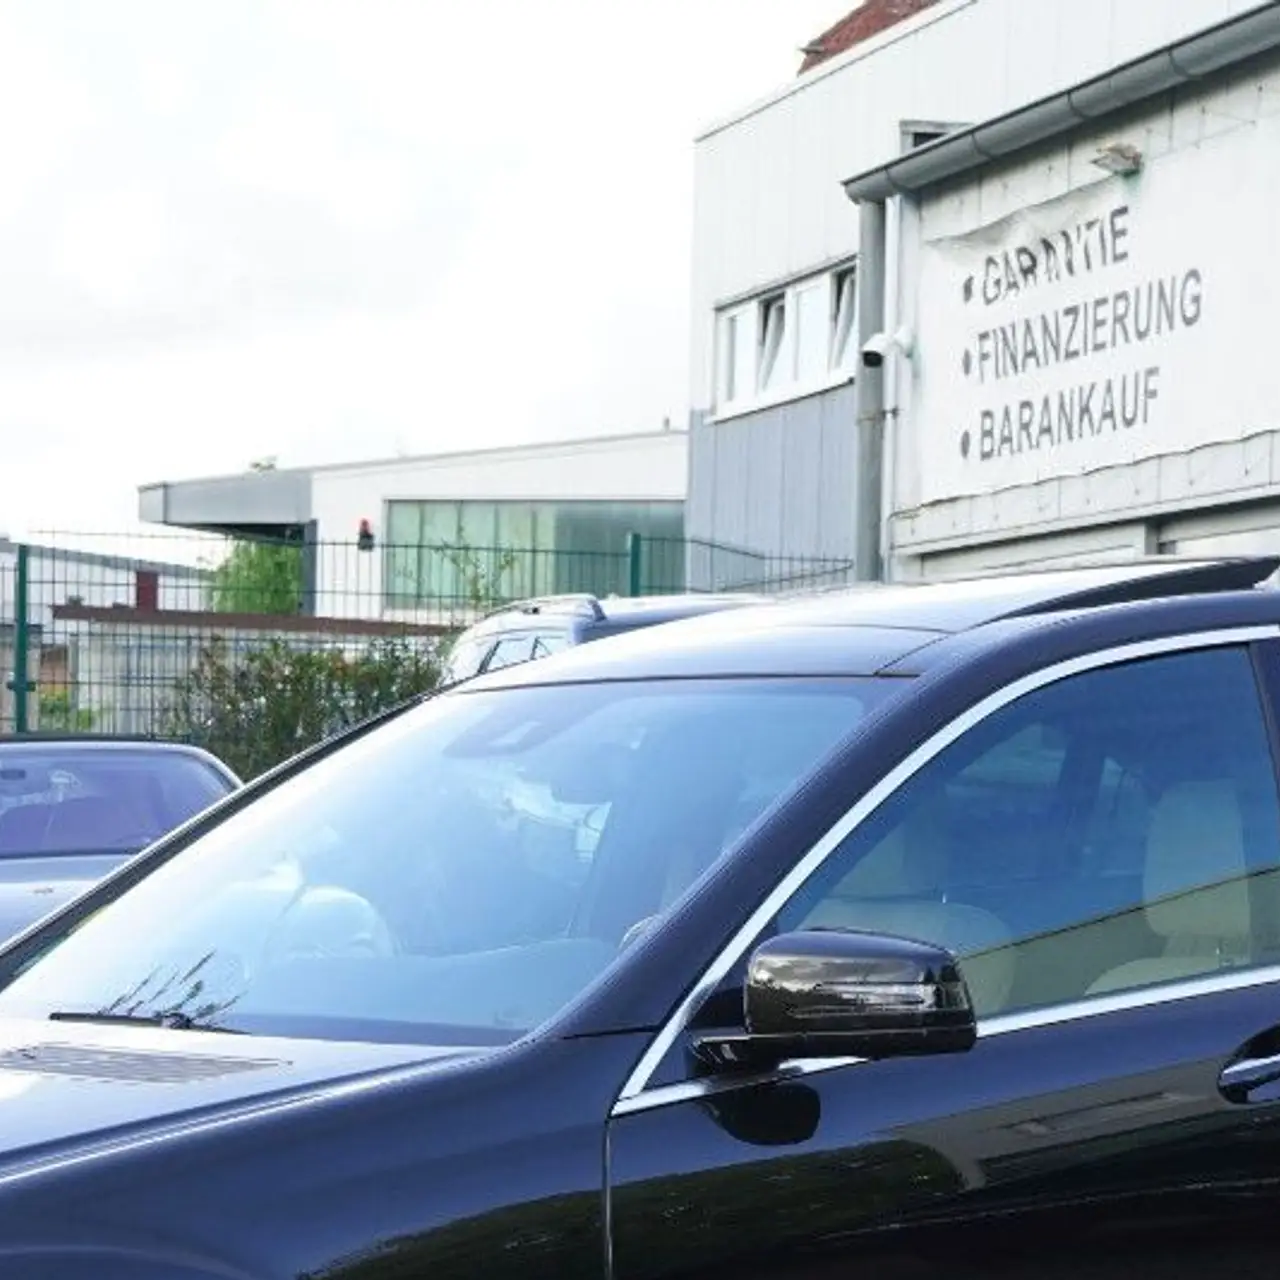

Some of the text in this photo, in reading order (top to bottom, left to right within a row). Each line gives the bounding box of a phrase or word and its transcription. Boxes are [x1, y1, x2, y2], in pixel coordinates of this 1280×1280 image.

[982, 205, 1129, 306] GARANTIE
[977, 268, 1202, 385] FINANZIERUNG
[979, 366, 1160, 462] BARANKAUF
